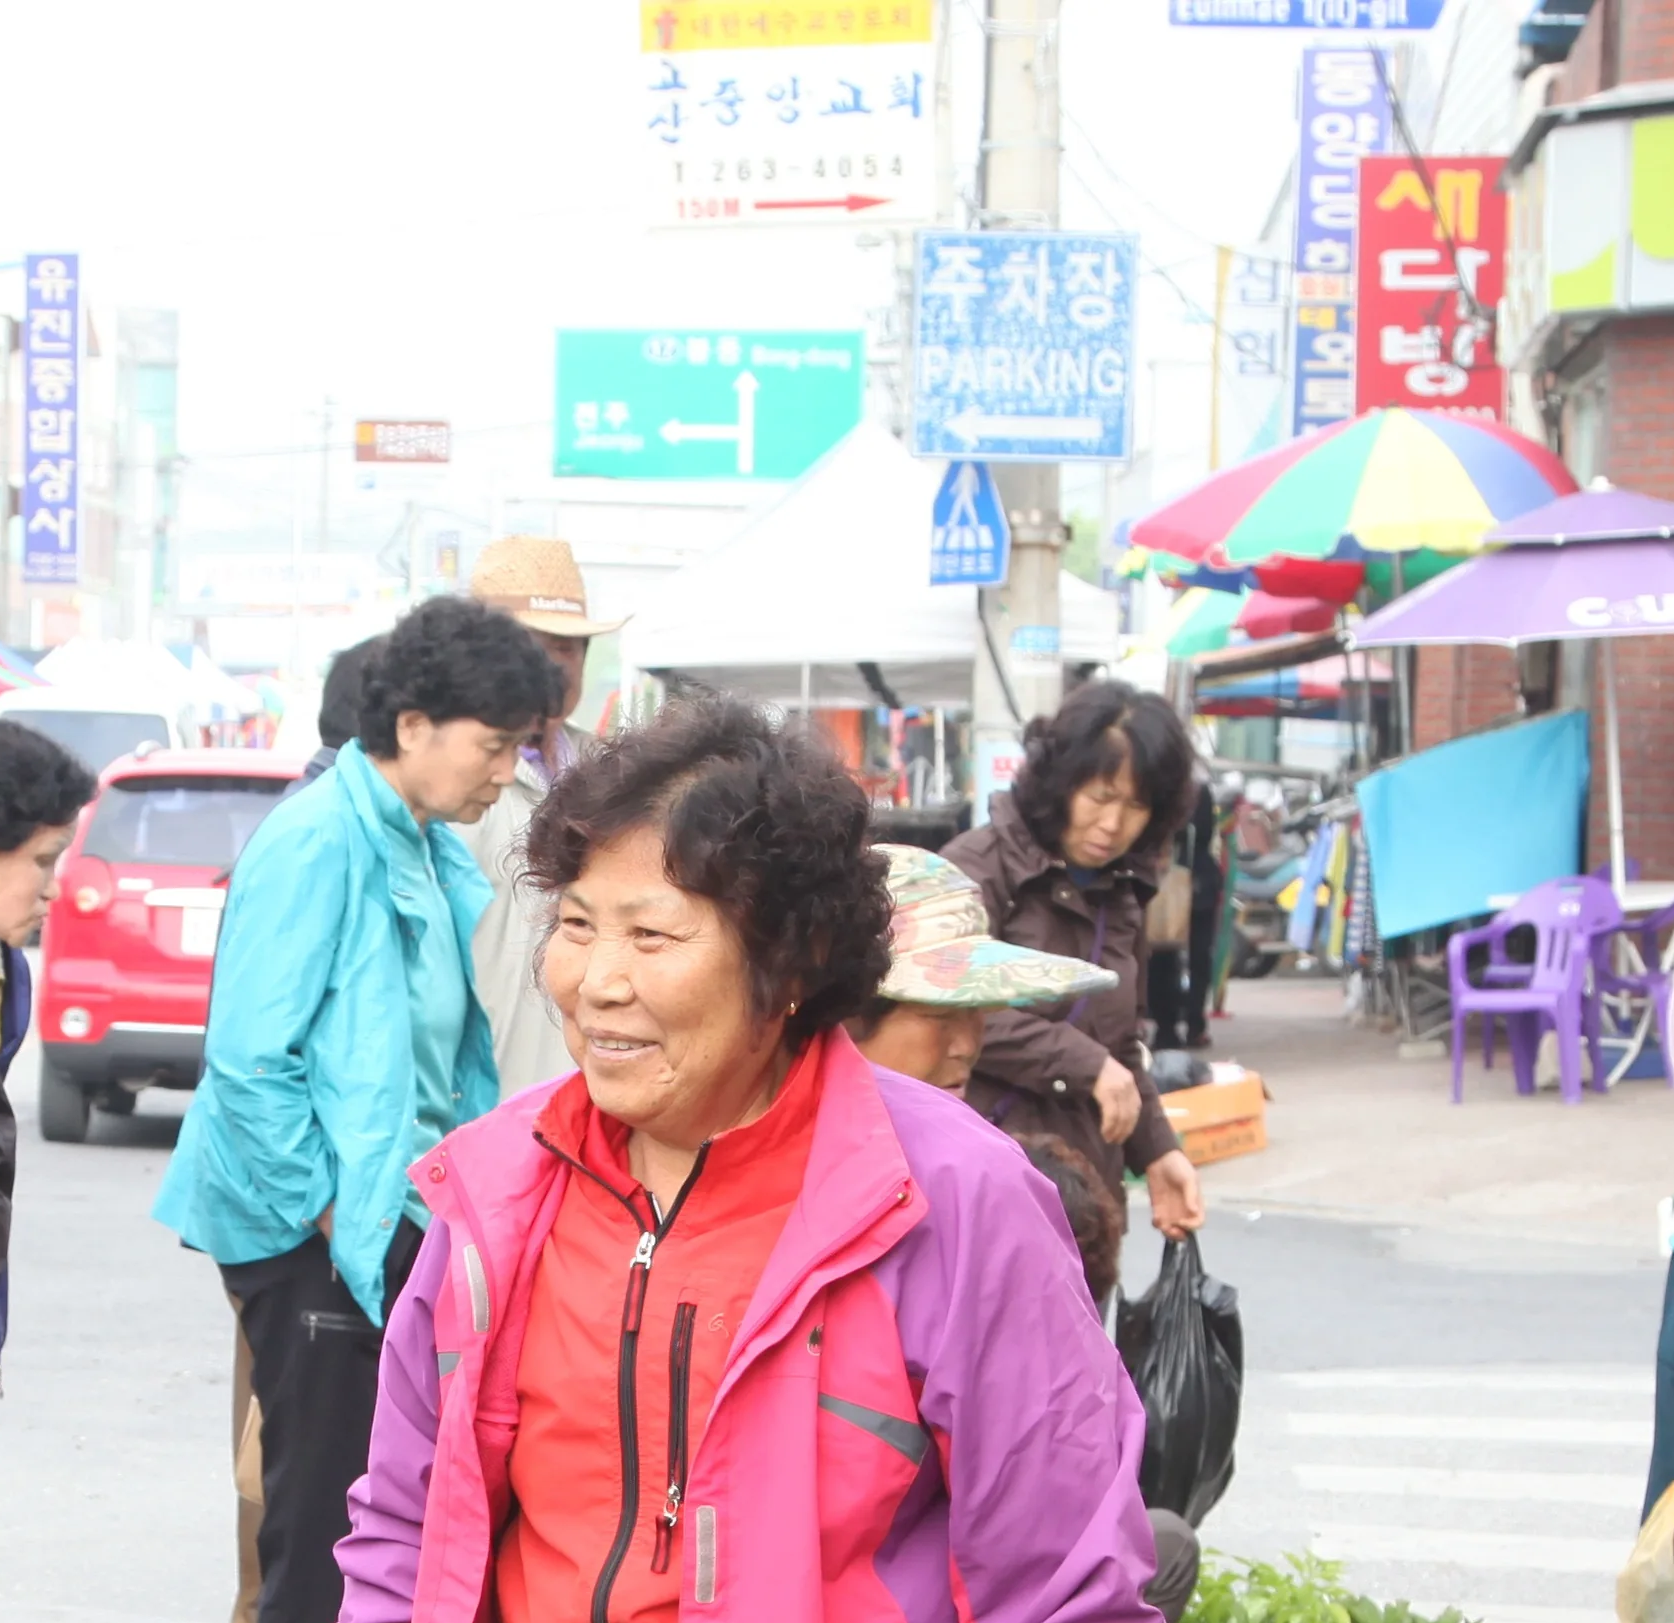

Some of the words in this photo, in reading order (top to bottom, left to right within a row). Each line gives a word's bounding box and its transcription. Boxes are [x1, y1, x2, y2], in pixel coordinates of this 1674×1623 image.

[698, 71, 924, 127] 중앙교회
[676, 197, 741, 219] 150M
[927, 245, 1124, 327] 주차장
[921, 344, 1125, 397] PARKING
[28, 258, 76, 551] 유진종합상사
